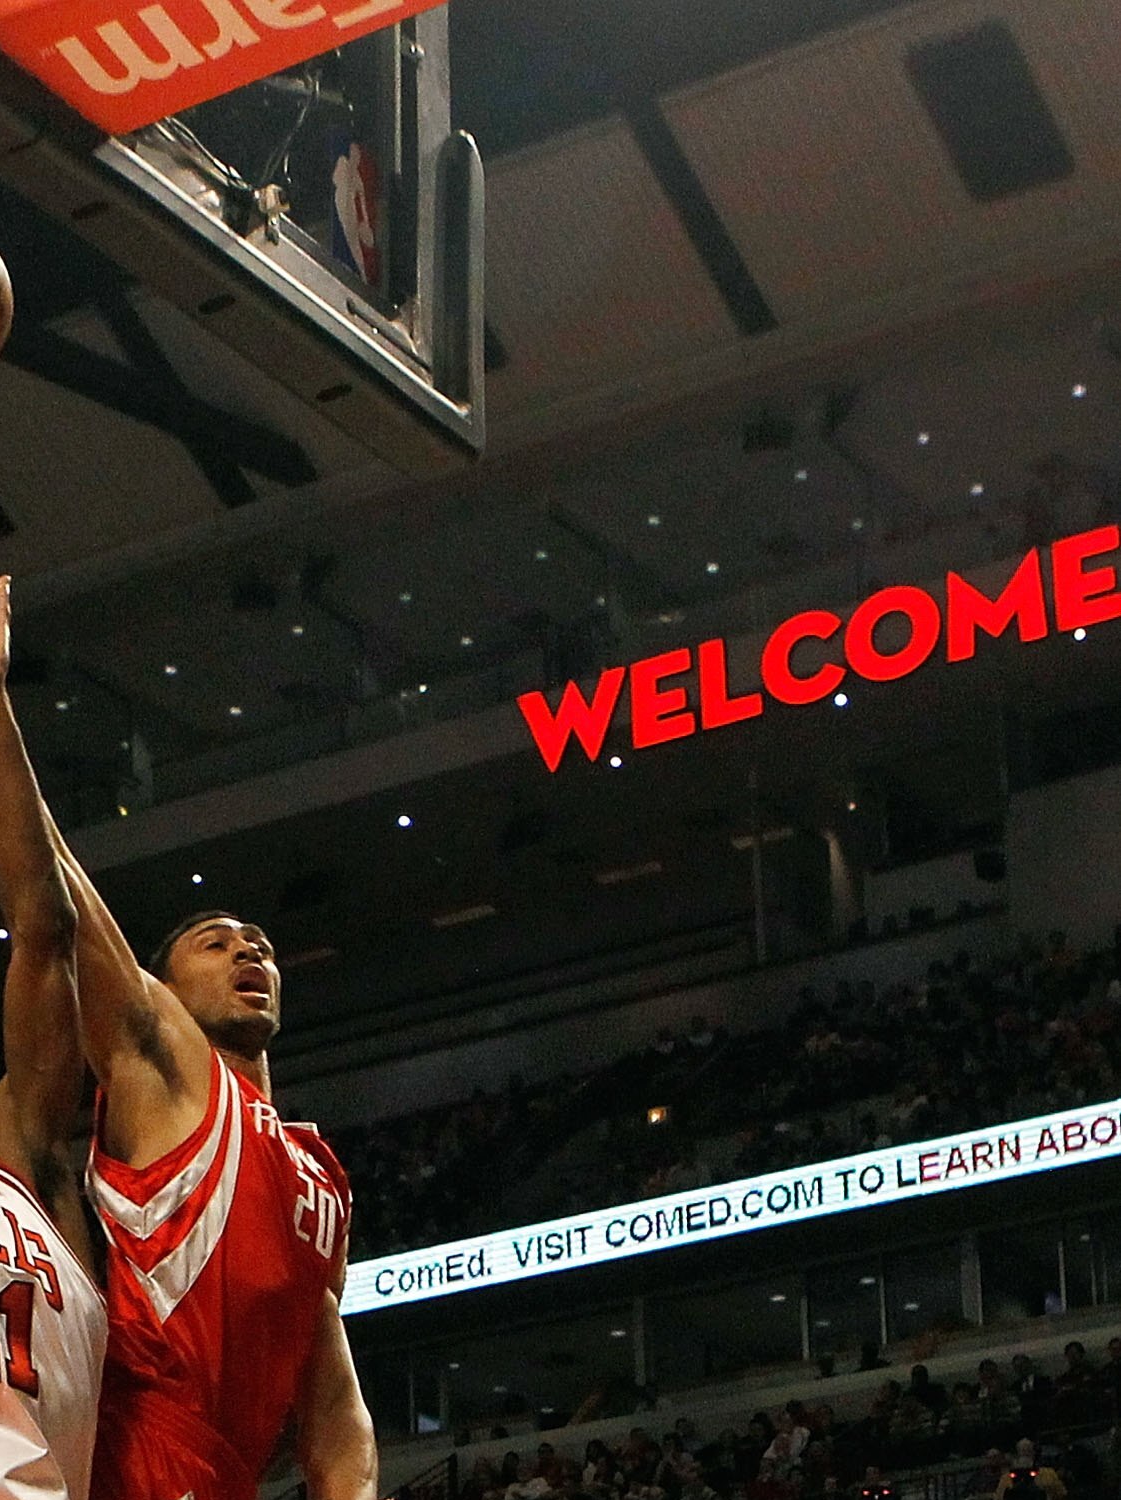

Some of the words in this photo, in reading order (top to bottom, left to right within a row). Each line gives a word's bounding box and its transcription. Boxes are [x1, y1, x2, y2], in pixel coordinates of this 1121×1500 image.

[516, 524, 1121, 773] WELCOME
[293, 1168, 336, 1260] 20
[375, 1249, 492, 1296] ComEd.
[512, 1225, 594, 1268] VISIT
[606, 1176, 824, 1248] COMED.COM
[835, 1164, 885, 1200] TO
[895, 1134, 1022, 1188] LEARN
[1035, 1113, 1121, 1160] ABO
